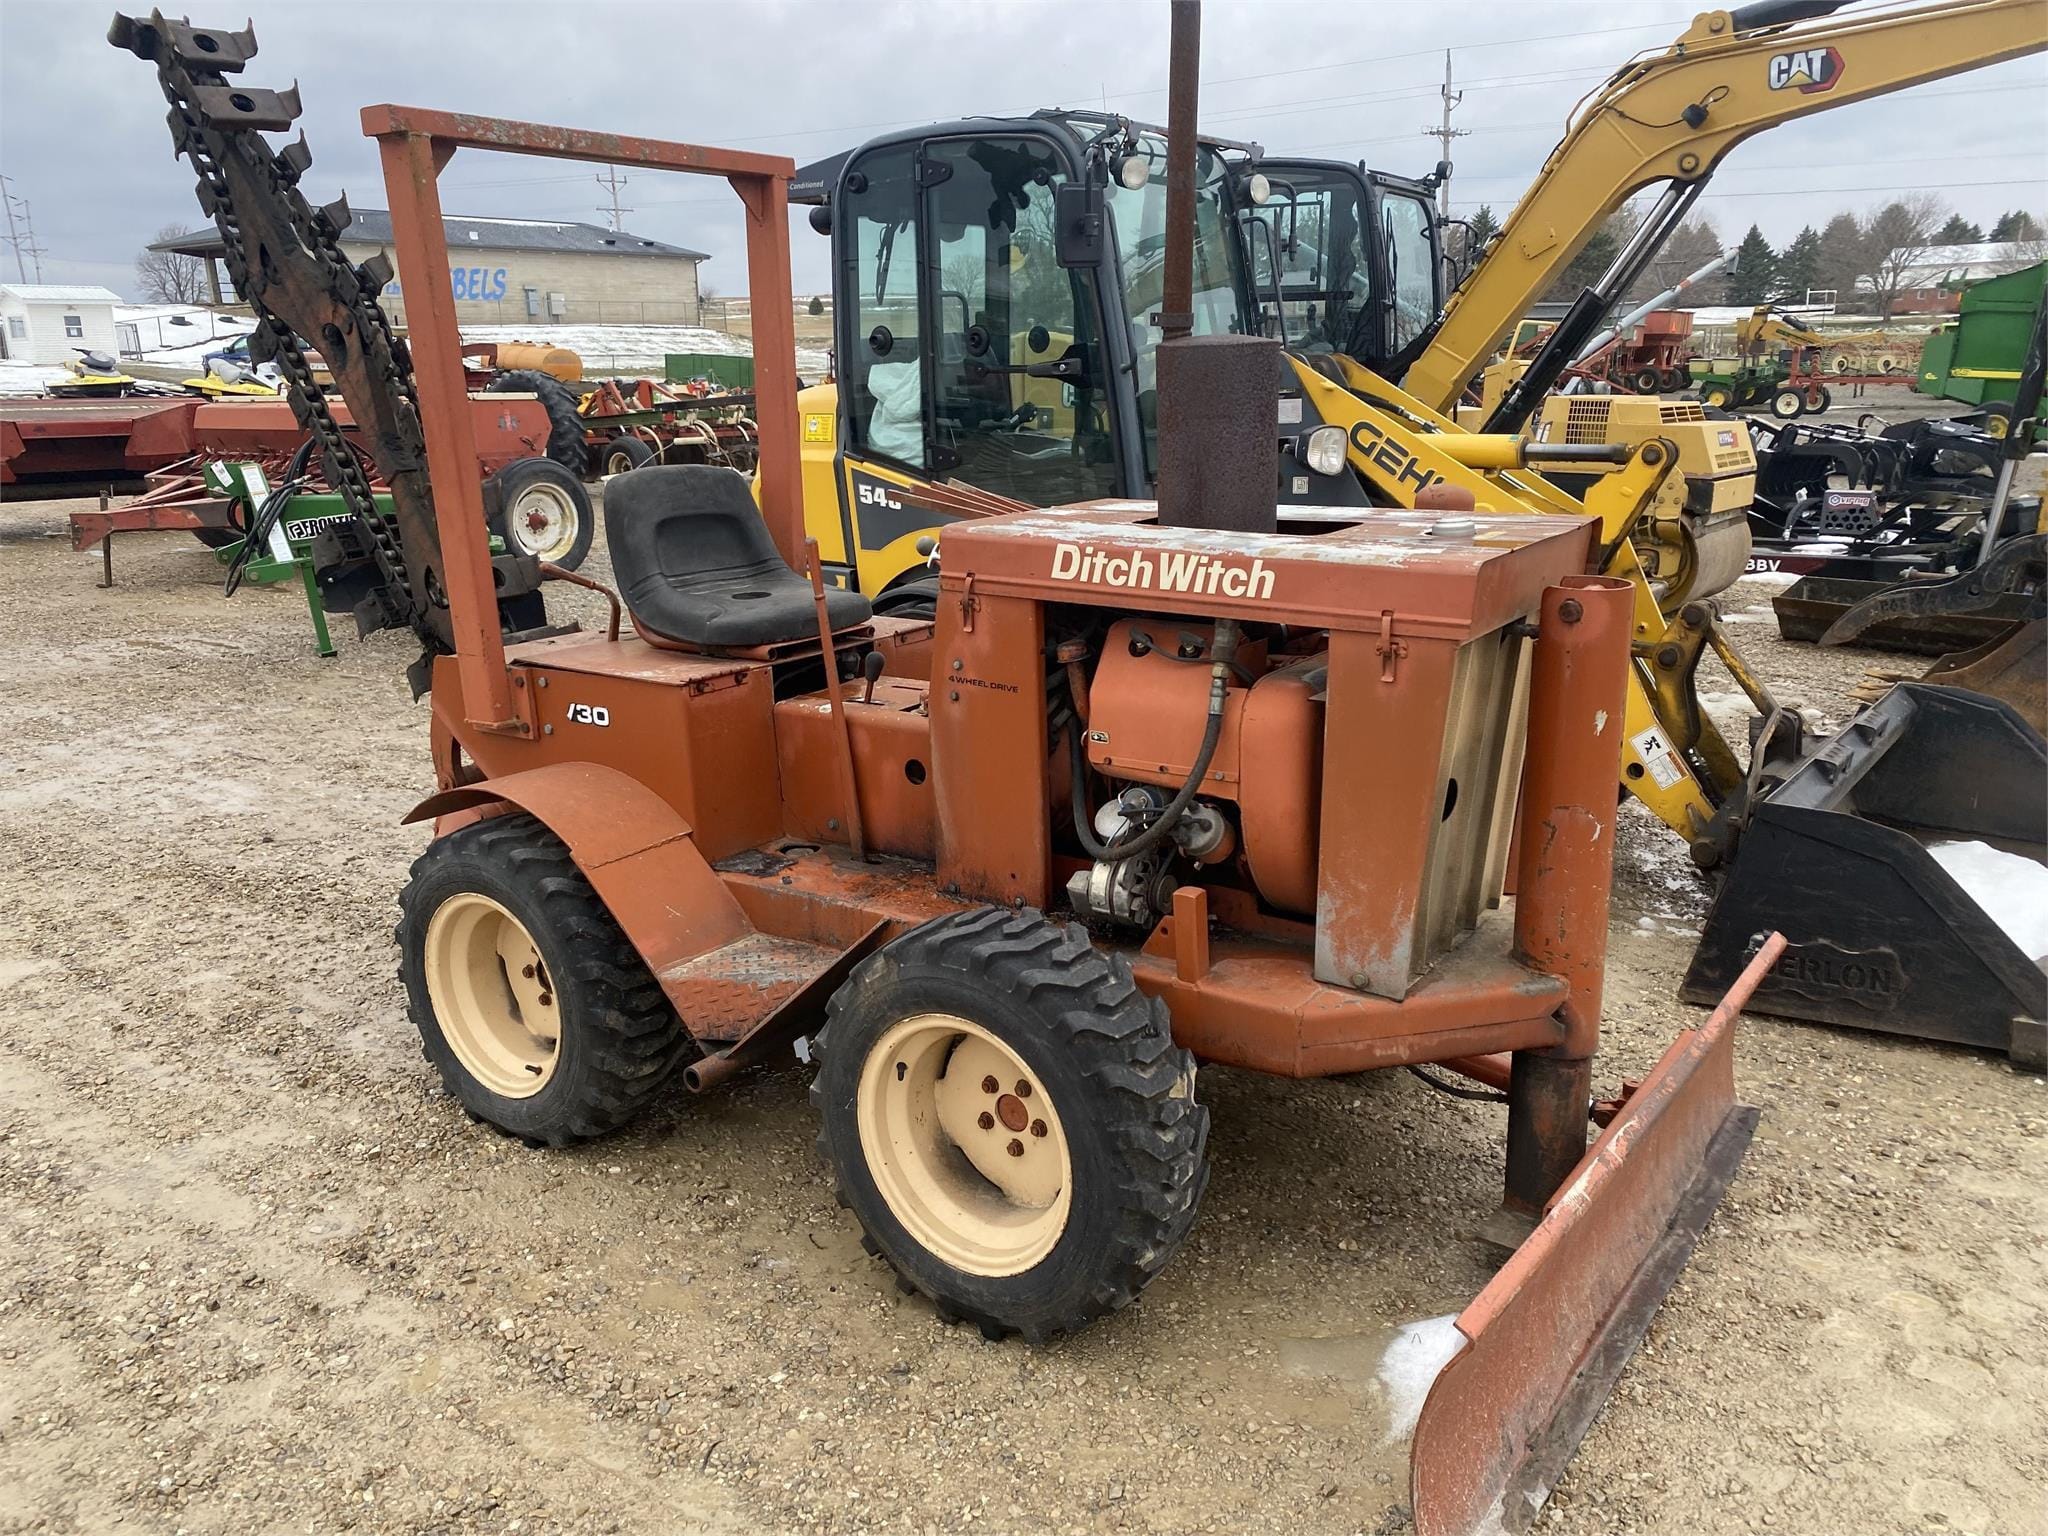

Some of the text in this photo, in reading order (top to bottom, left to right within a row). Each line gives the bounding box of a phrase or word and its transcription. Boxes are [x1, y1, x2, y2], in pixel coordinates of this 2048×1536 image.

[1770, 48, 1827, 89] CAT
[449, 266, 507, 300] BELS
[1349, 420, 1446, 494] GEH
[1050, 543, 1276, 599] Ditch Witch
[955, 676, 989, 688] WHEEL
[990, 682, 1019, 694] DRIVE
[1766, 955, 1892, 994] ERLON
